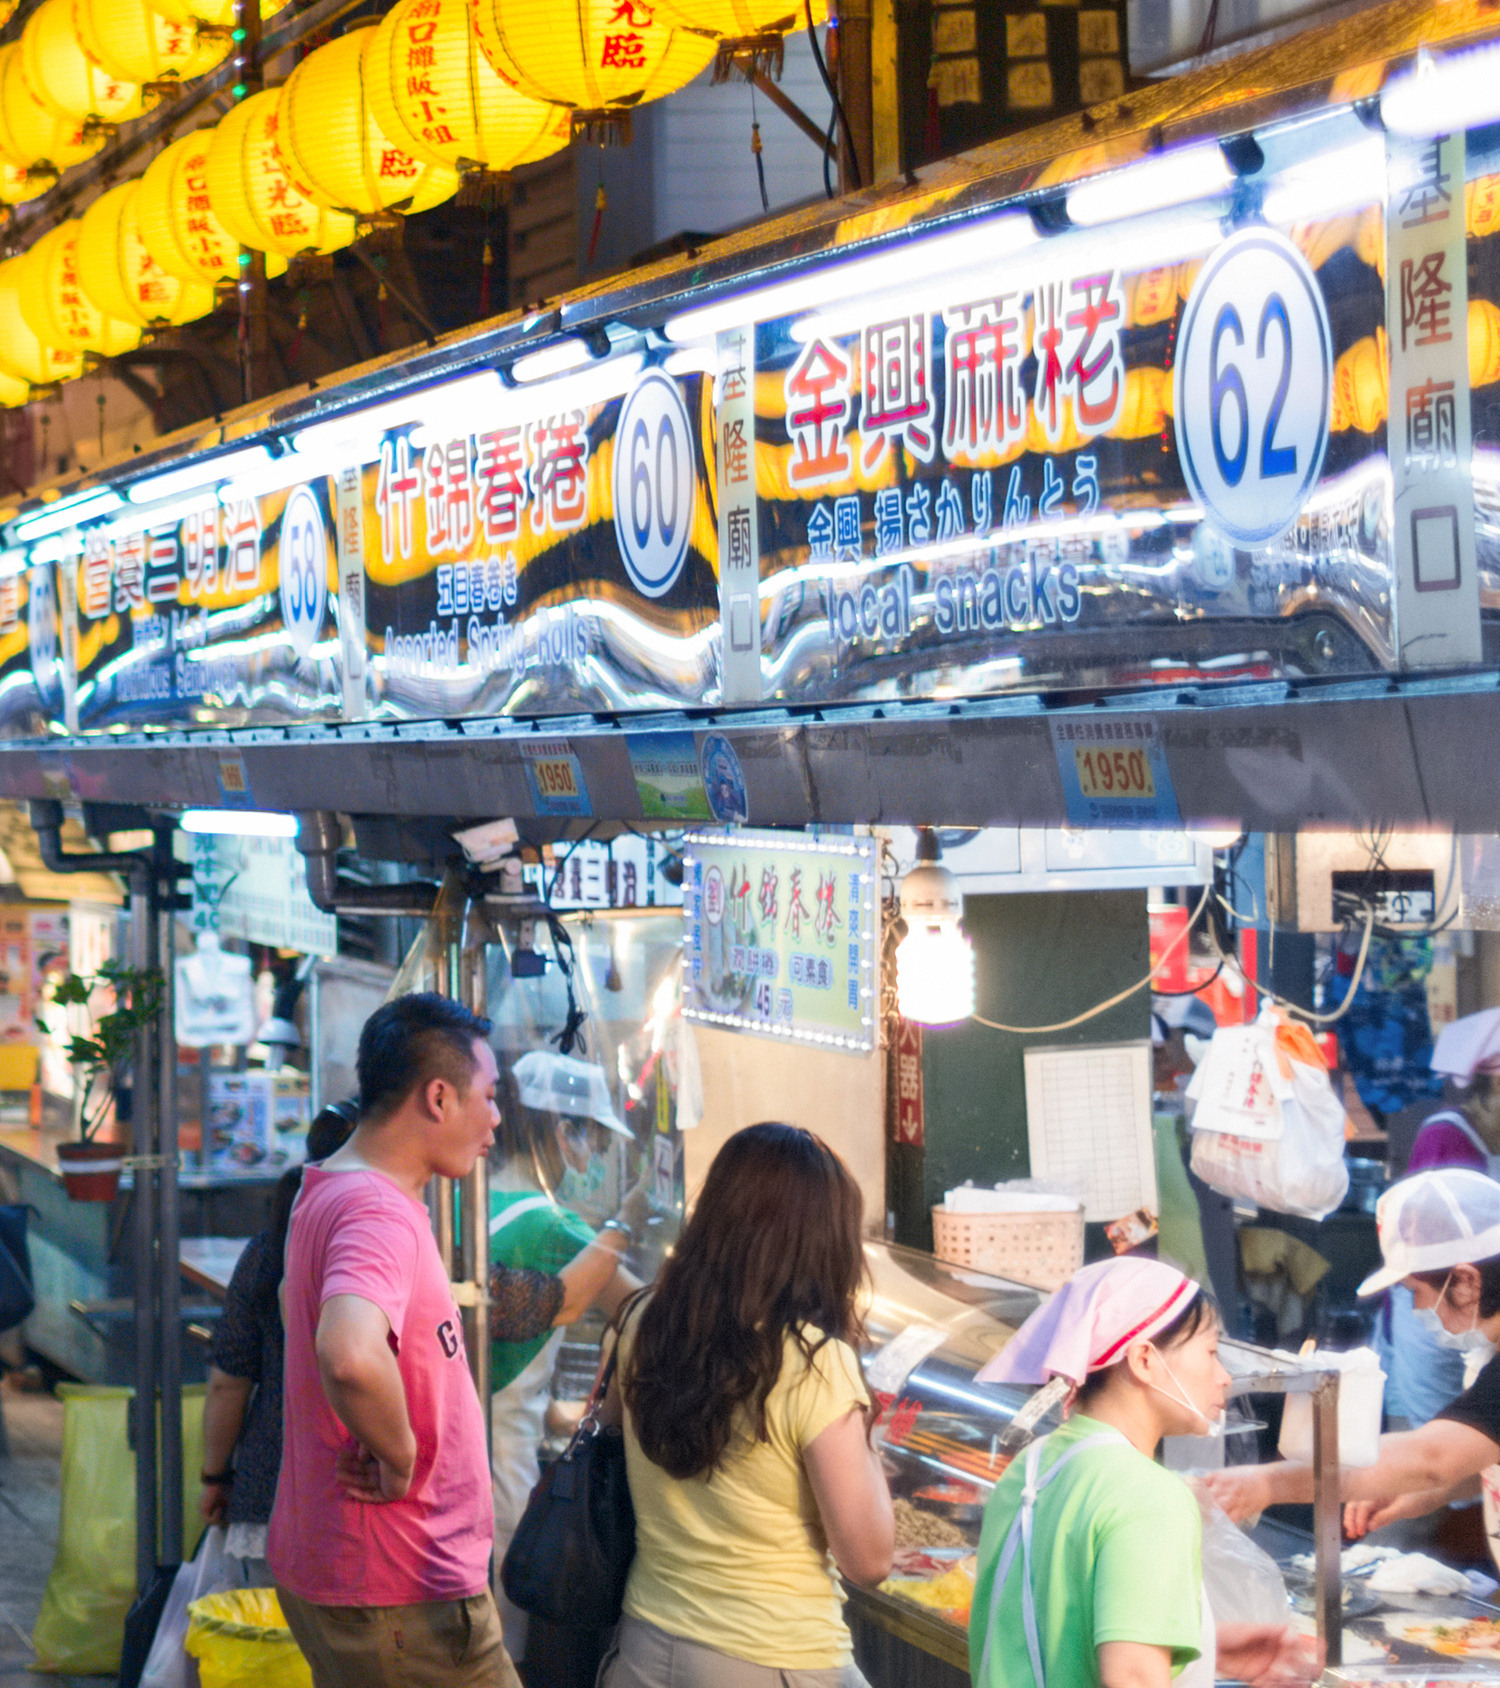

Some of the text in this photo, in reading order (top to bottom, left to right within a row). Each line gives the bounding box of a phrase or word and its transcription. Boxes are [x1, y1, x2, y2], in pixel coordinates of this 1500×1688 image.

[1211, 290, 1298, 488] 62
[630, 412, 679, 549] 60
[289, 555, 318, 622] 58
[825, 549, 1082, 643] local snacks
[384, 606, 587, 676] Assorted Spring Rolls
[537, 762, 574, 794] 1950
[1083, 749, 1146, 791] 1950
